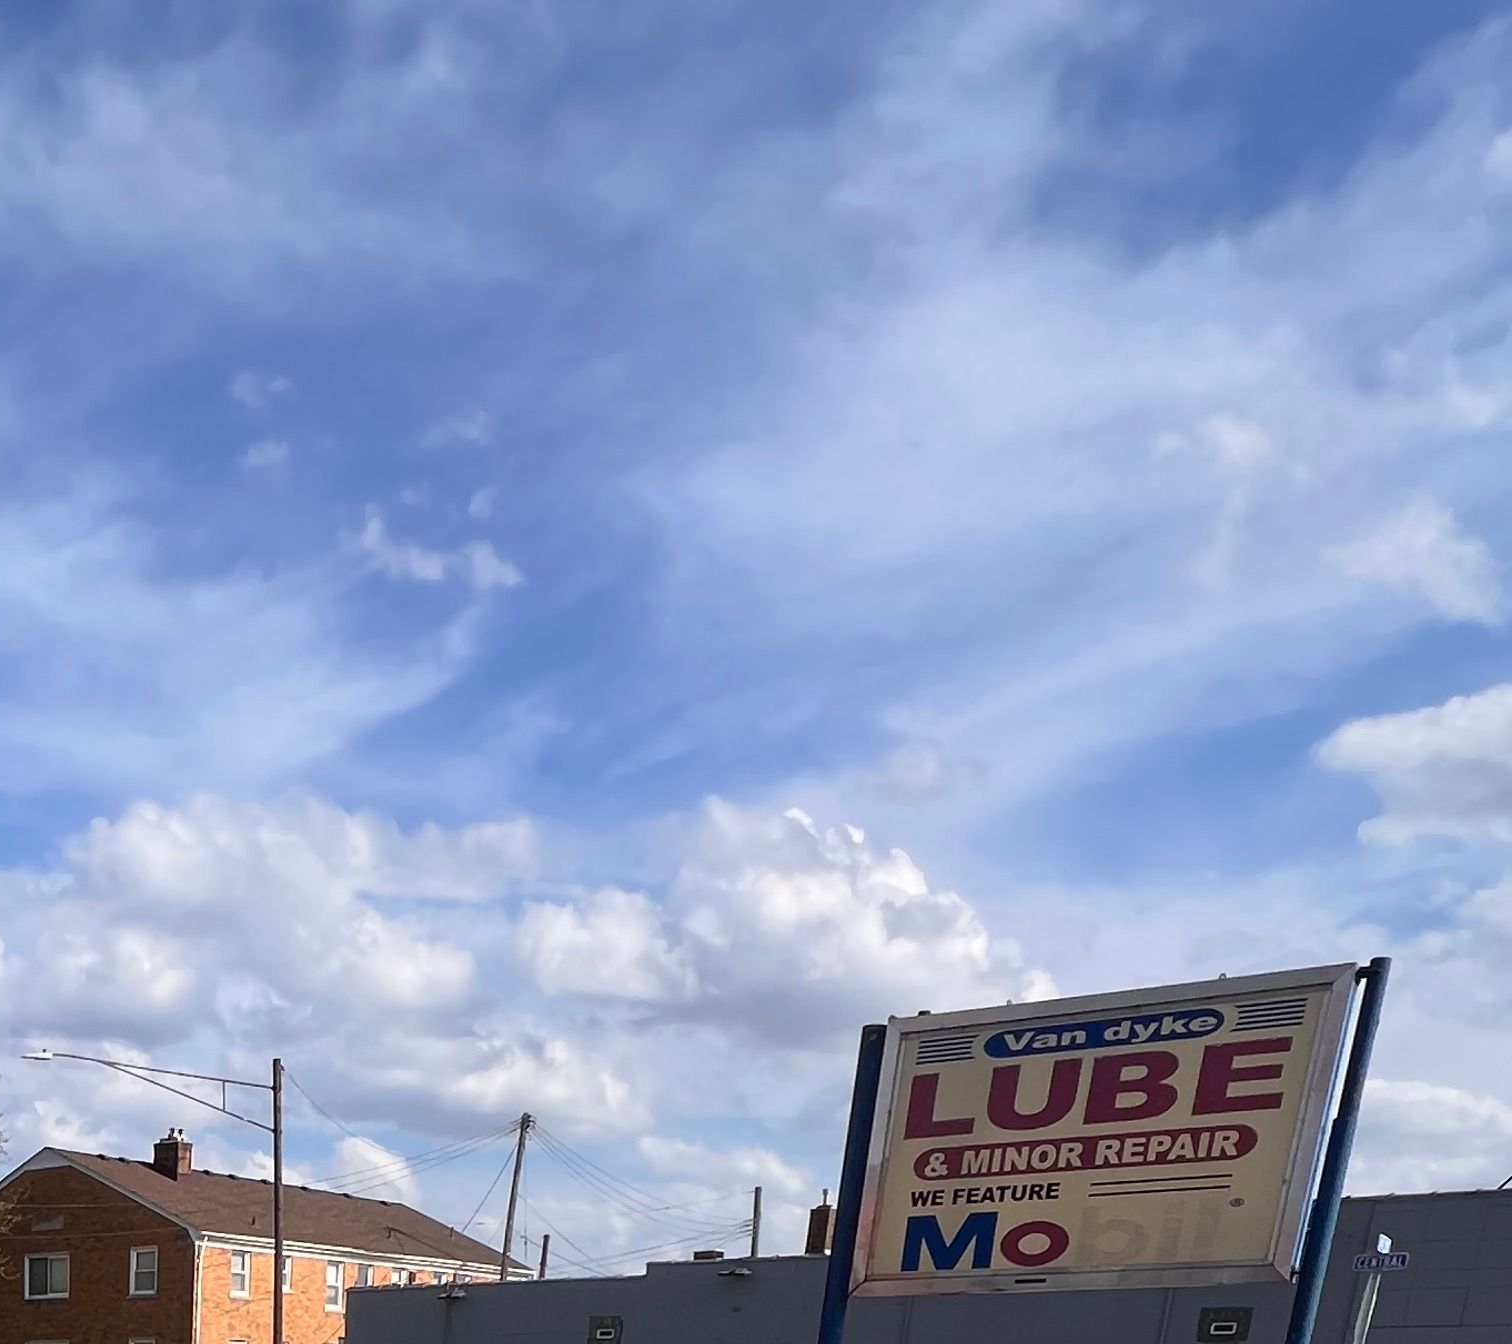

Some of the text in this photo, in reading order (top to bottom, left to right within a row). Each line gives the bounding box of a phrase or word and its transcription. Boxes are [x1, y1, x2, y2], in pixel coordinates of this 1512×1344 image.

[1003, 1013, 1218, 1054] Van dyke
[904, 1036, 1293, 1140] LUBE
[924, 1129, 1240, 1178] & MINOR REPAIR
[910, 1182, 1061, 1208] WE FEATURE
